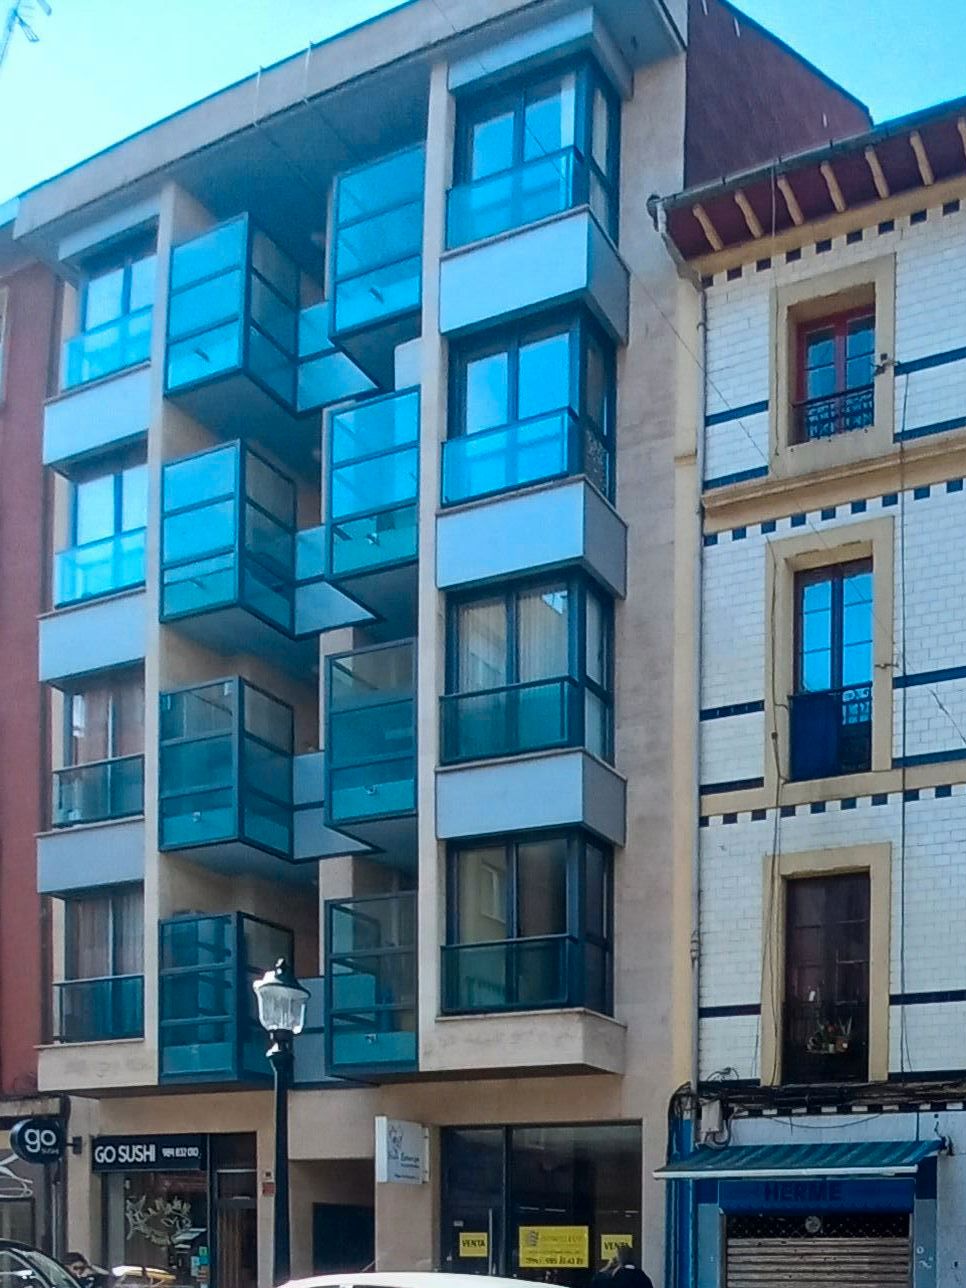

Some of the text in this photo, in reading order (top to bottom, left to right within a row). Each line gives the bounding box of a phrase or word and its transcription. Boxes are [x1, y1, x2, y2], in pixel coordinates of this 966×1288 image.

[24, 1128, 57, 1153] go
[95, 1145, 116, 1163] GO
[118, 1144, 156, 1163] SUSHI
[462, 1239, 486, 1248] VENTA
